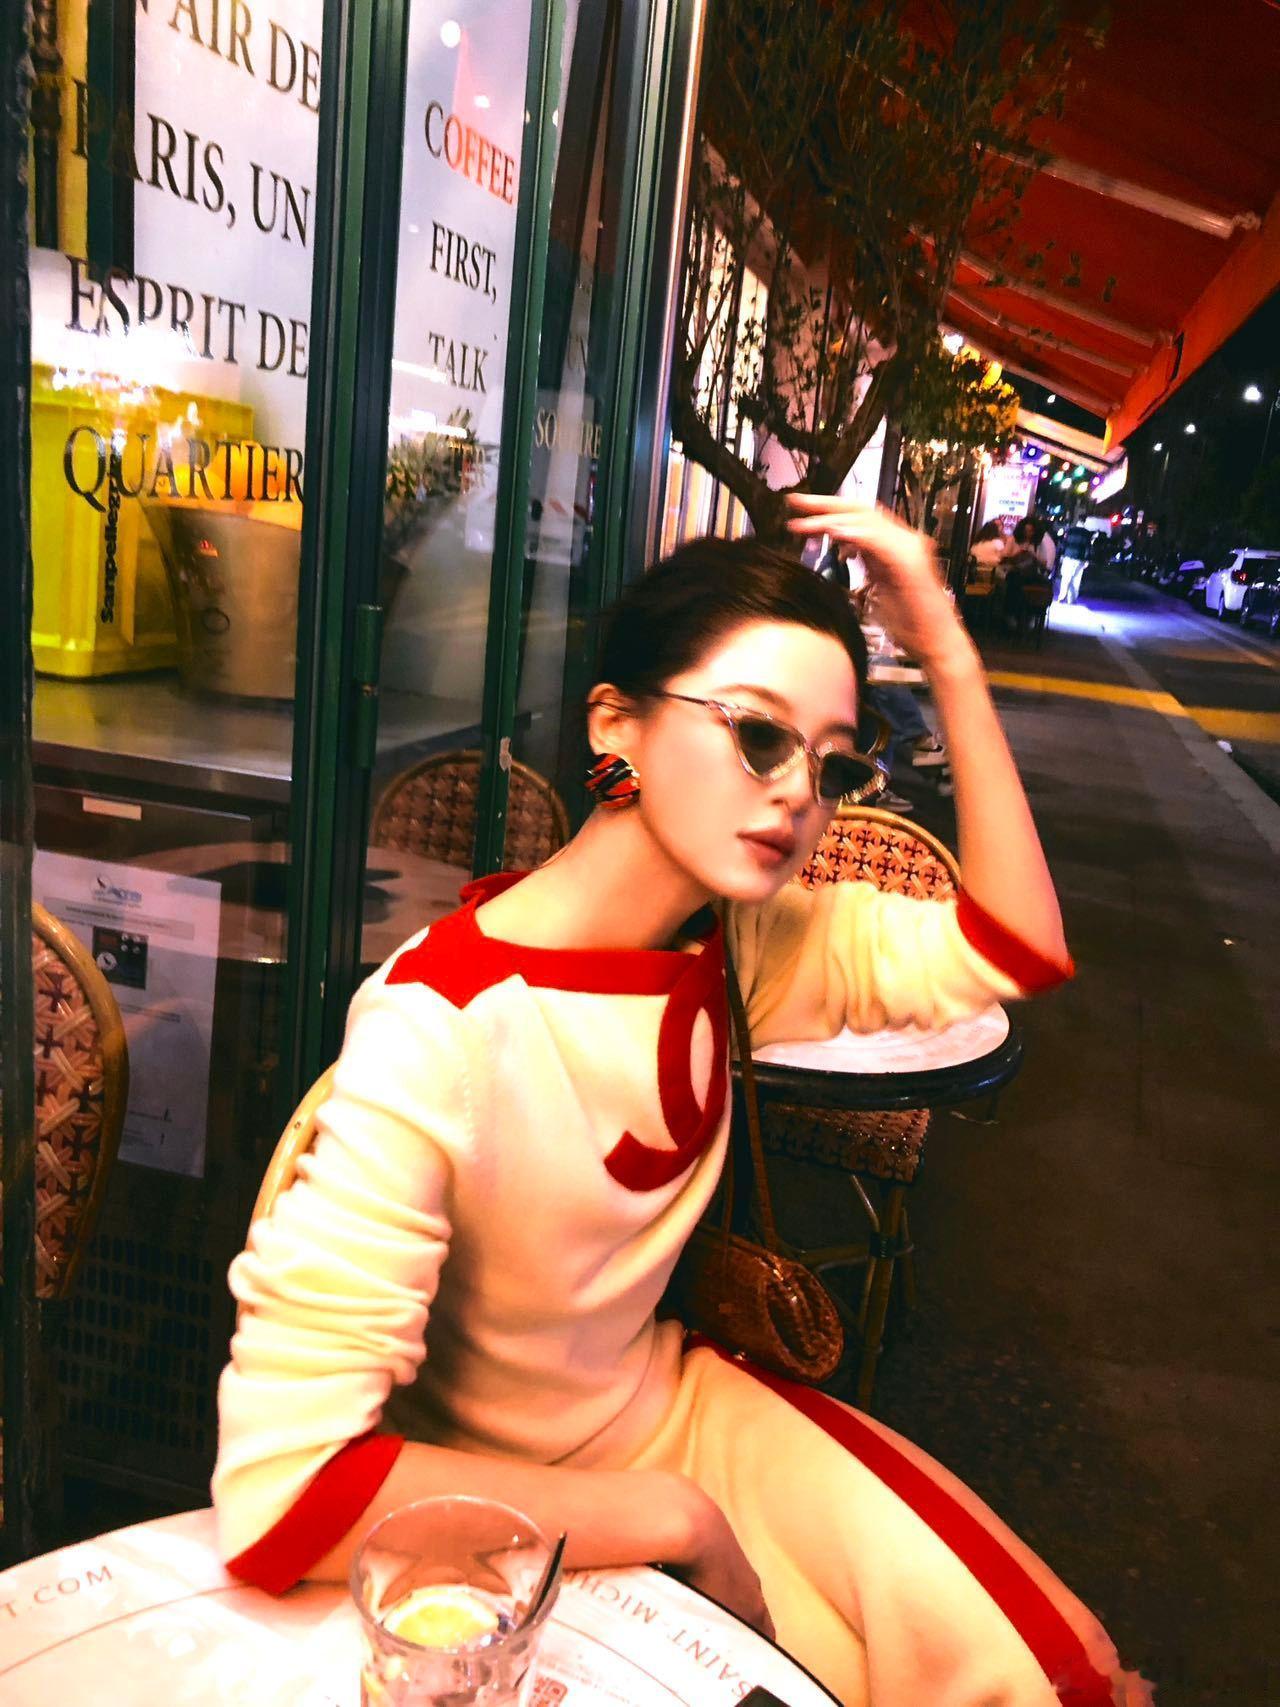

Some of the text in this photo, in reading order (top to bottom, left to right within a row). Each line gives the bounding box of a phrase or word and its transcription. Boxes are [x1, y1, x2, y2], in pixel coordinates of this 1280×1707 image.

[266, 19, 320, 113] DE
[425, 99, 515, 205] COFFEE
[250, 161, 311, 247] UN
[430, 220, 497, 304] FIRST,
[65, 254, 308, 378] ESPRIT DE
[428, 331, 489, 394] TALK
[63, 425, 304, 513] QUARTIER
